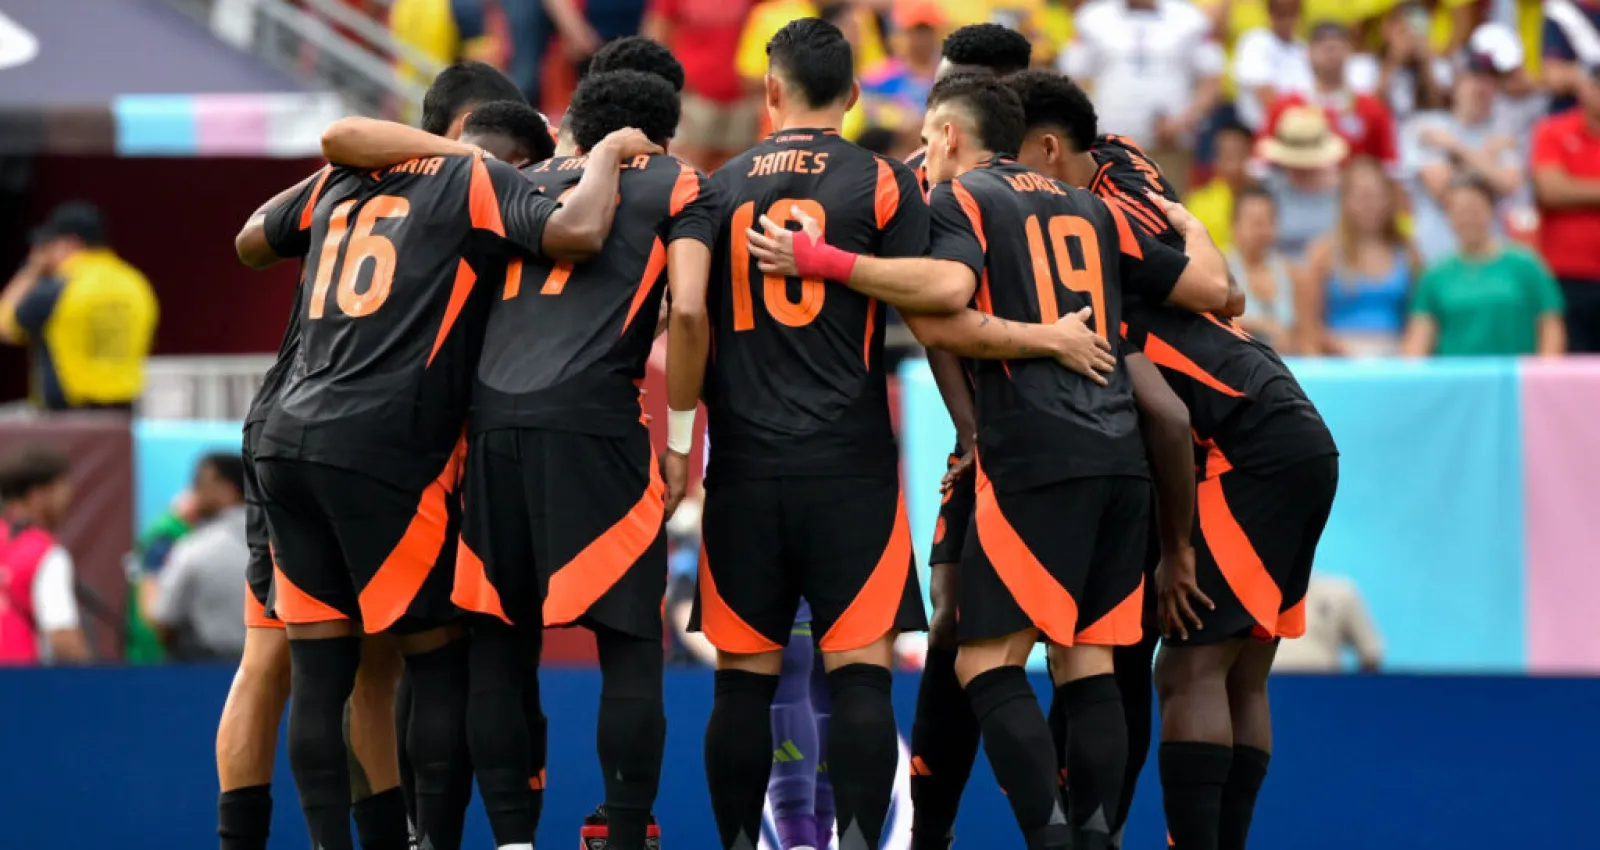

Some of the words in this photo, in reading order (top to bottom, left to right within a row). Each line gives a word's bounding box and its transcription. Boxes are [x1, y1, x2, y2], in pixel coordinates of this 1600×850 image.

[747, 149, 829, 178] JAMES
[308, 194, 411, 320] 16
[1025, 214, 1108, 345] 19
